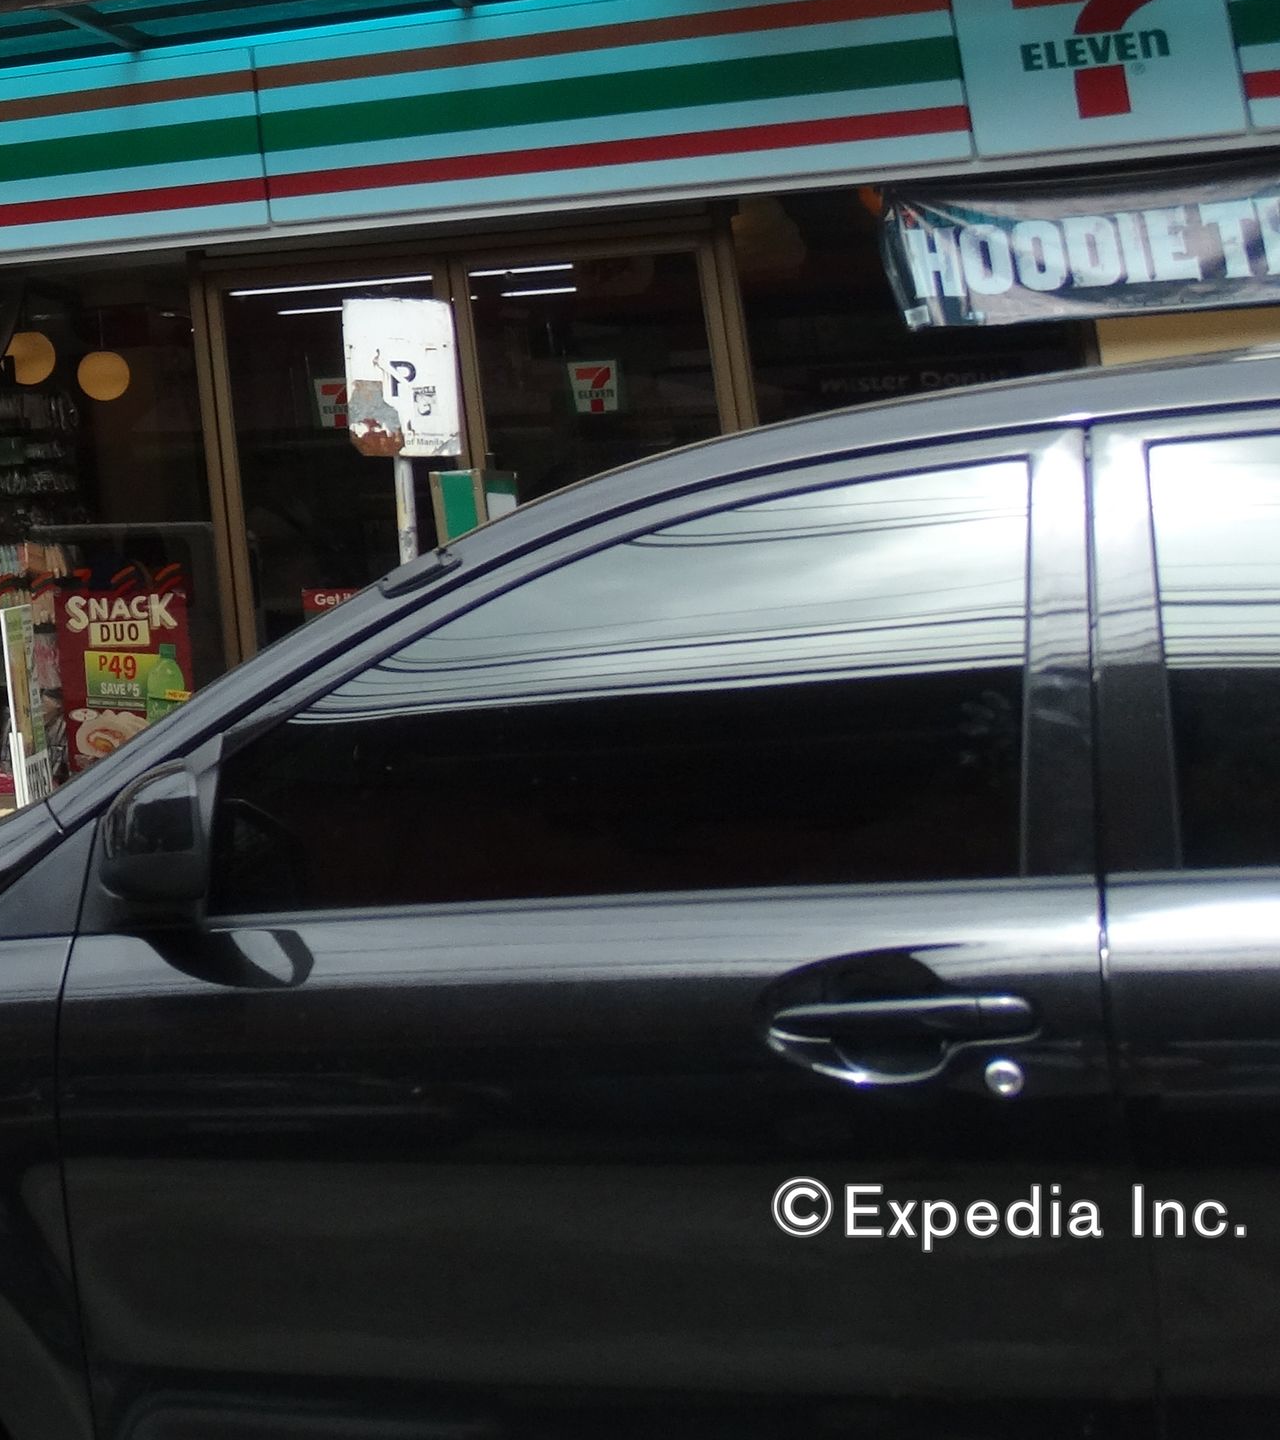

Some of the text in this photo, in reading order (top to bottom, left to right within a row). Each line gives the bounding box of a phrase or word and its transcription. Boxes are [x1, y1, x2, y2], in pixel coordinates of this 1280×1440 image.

[389, 360, 417, 397] P
[65, 592, 179, 633] SNACK
[100, 623, 141, 642] DUO
[100, 682, 127, 696] SAVE
